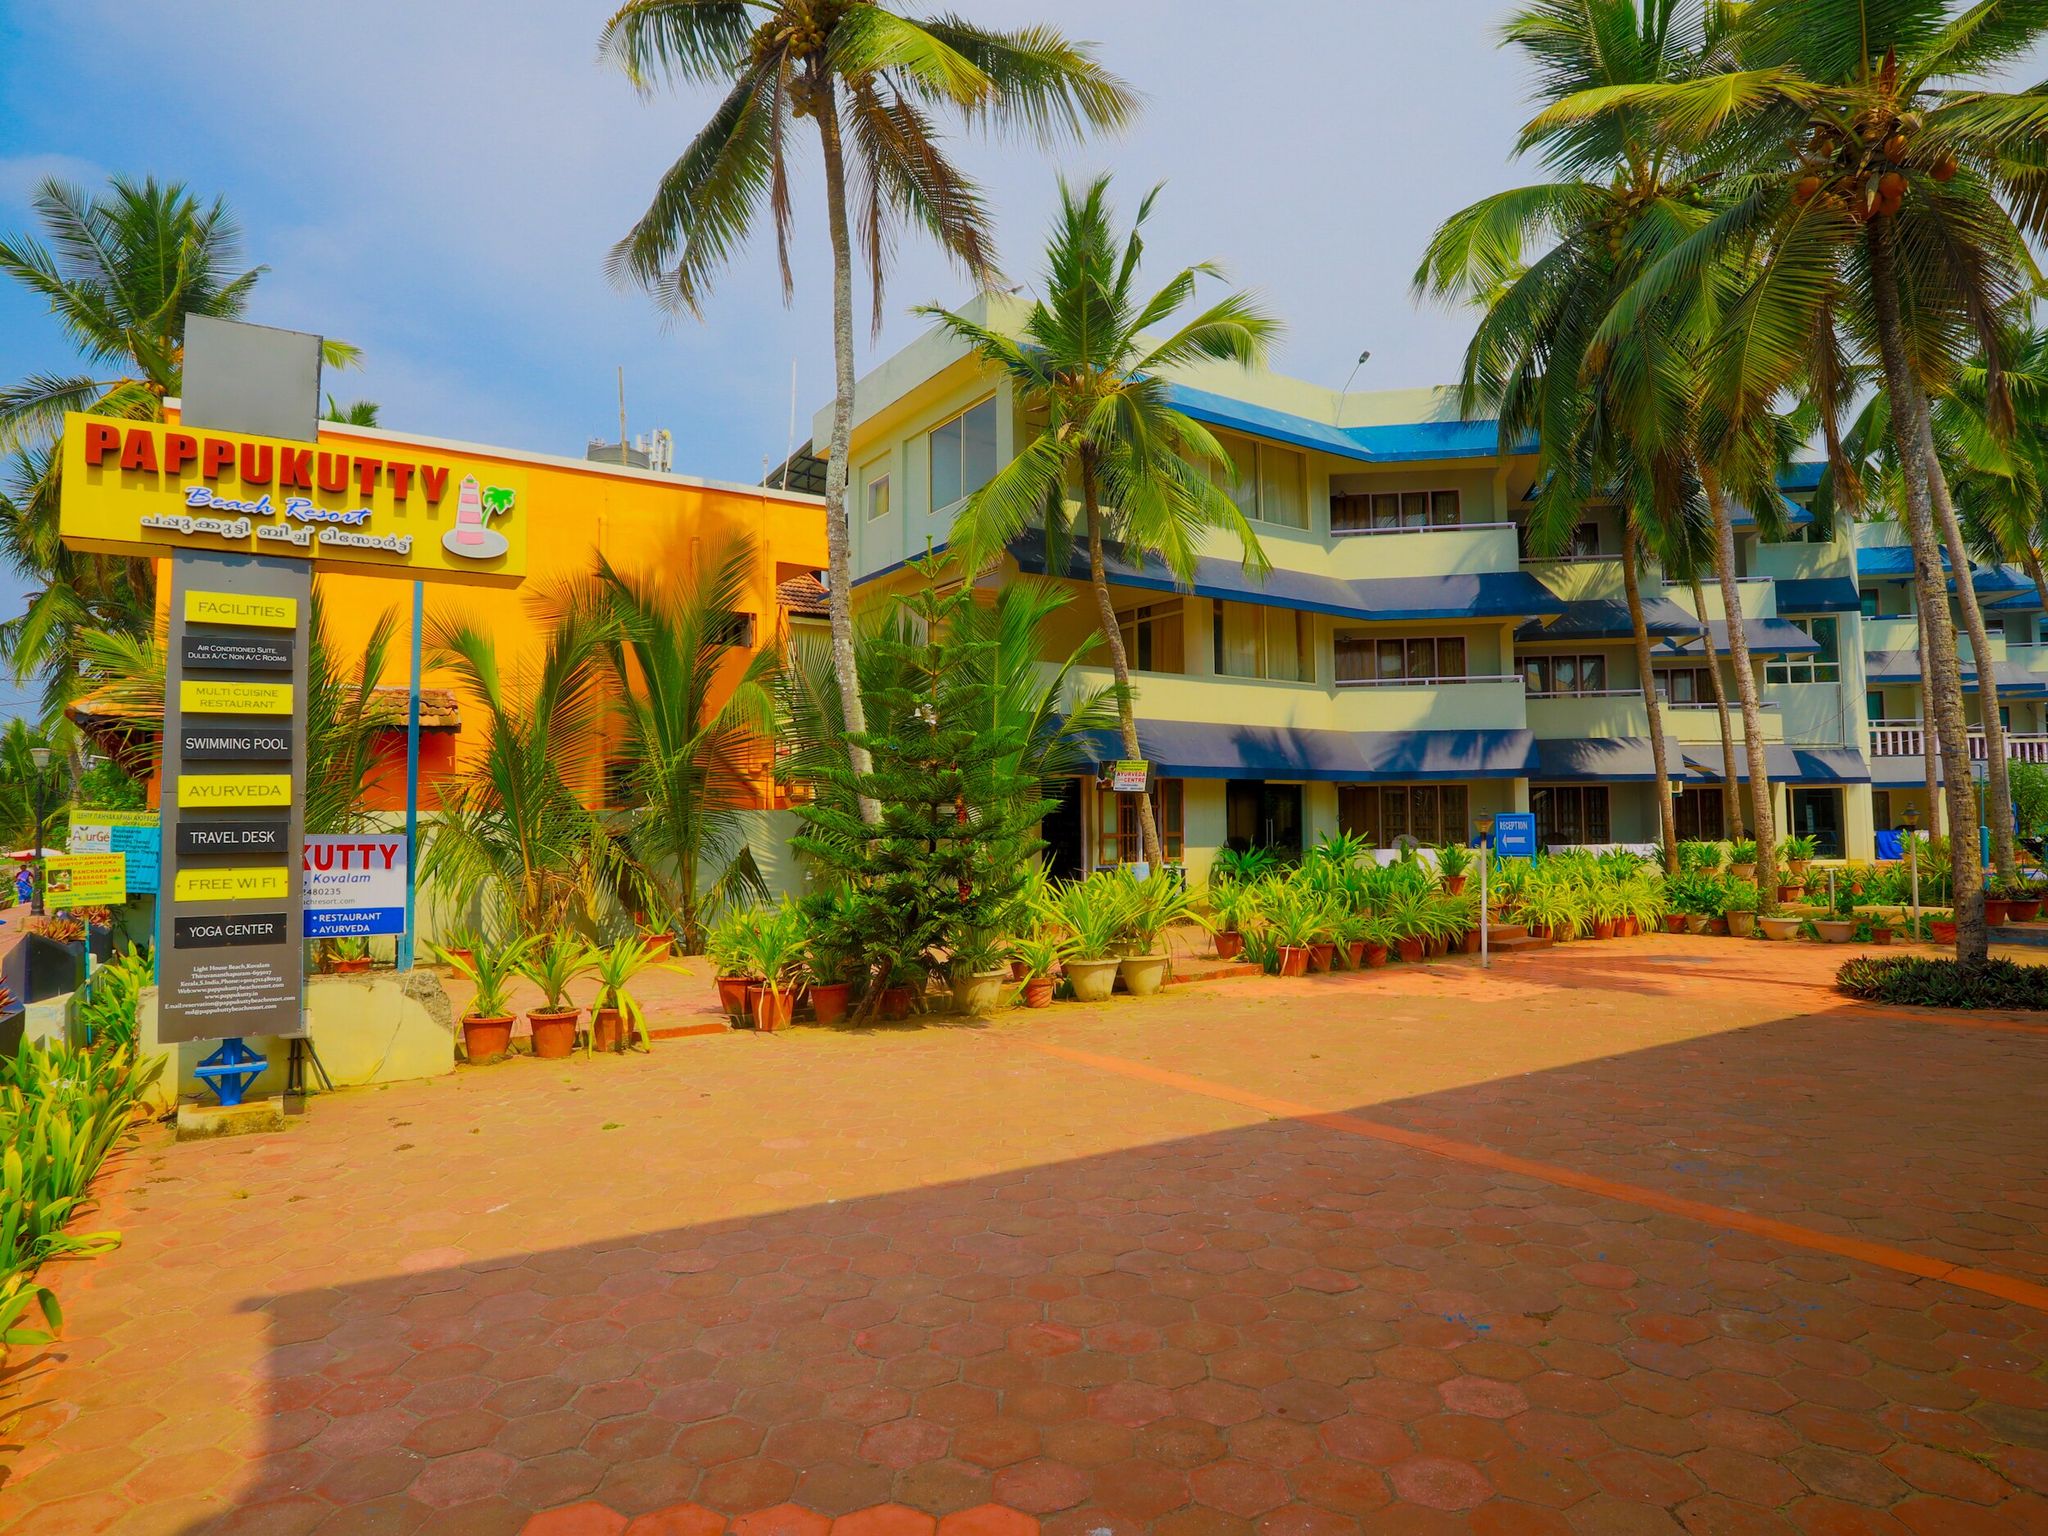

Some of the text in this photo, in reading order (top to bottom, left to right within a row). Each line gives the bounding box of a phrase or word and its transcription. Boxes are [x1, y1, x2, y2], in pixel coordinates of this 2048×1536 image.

[85, 422, 450, 504] PAPPUKUTTY
[186, 487, 372, 525] Beach Resort
[198, 601, 286, 618] FACILITIES
[211, 652, 228, 660] A/C
[246, 653, 262, 661] A/C
[195, 687, 279, 698] MULTI CUISINE
[199, 699, 276, 709] RESTAURANT
[185, 737, 288, 750] SWIMMING POOL
[188, 785, 282, 797] AYURVEDA
[1499, 820, 1528, 831] RECEPTION
[190, 831, 275, 844] TRAVEL DESK
[189, 877, 276, 890] FREE WI FI
[313, 873, 371, 884] Kovalam
[319, 912, 382, 922] RESTAURANT
[189, 924, 273, 938] YOGA CENTER
[319, 924, 370, 933] AYURVEDA
